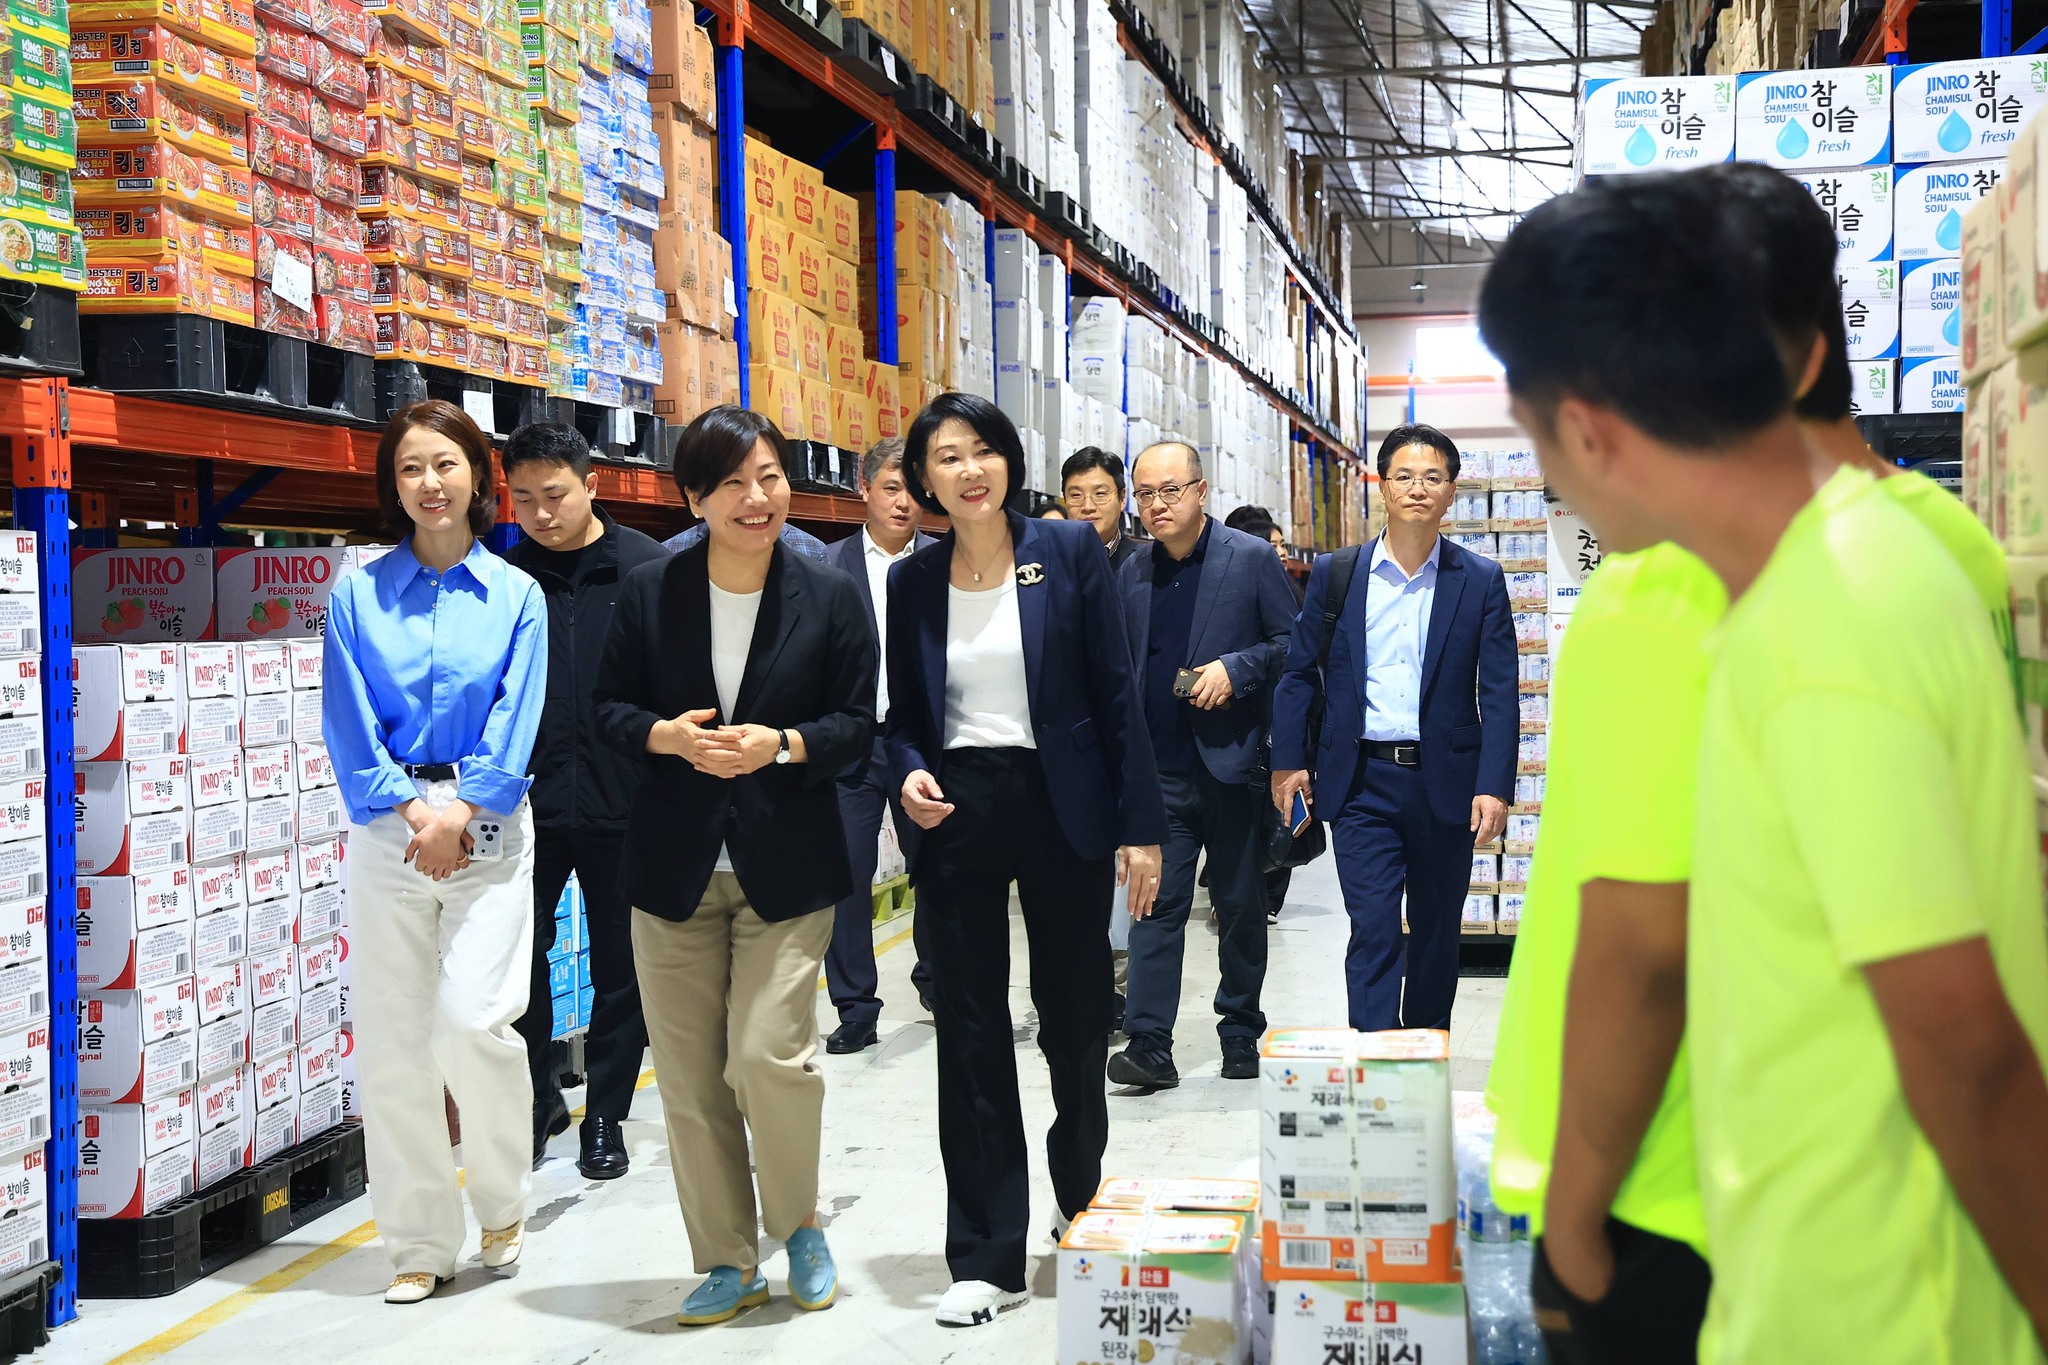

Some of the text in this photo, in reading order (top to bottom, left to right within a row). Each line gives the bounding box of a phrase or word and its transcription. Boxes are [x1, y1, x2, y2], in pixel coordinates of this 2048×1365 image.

[72, 32, 106, 41] OBSTER
[112, 34, 126, 56] 킹
[22, 39, 42, 54] KING
[1926, 74, 1970, 96] JINRO
[1974, 70, 2001, 98] 참
[73, 90, 101, 98] BSTER
[1615, 90, 1658, 109] JINRO
[1660, 88, 1686, 115] 참
[1766, 84, 1808, 104] JINRO
[1810, 80, 1837, 108] 참
[1925, 93, 1972, 105] CHAMISUL
[22, 103, 42, 118] KING
[1615, 109, 1659, 118] CHAMISUL
[1764, 103, 1810, 113] CHAMISUL
[1926, 106, 1948, 116] SOJU
[1975, 94, 2024, 124] 이슬
[1615, 120, 1636, 129] SOJU
[1661, 114, 1706, 141] 이슬
[1764, 115, 1786, 124] SOJU
[1812, 105, 1858, 132] 이슬
[1980, 129, 2016, 145] fresh
[77, 150, 108, 158] OBSTER
[1665, 146, 1698, 160] fresh
[1817, 140, 1850, 154] fresh
[116, 152, 130, 174] 킹
[20, 166, 40, 182] KING
[1815, 179, 1842, 206] 참
[1926, 173, 1969, 194] JINRO
[1924, 192, 1972, 204] CHAMISUL
[75, 210, 110, 218] OBSTER
[1925, 204, 1948, 213] SOJU
[115, 212, 131, 234] 킹
[35, 229, 56, 244] KING
[36, 241, 57, 255] NOODLE
[88, 268, 123, 277] OBSTER
[1931, 272, 1960, 290] JINR
[128, 271, 159, 294] 킹 컵
[1930, 290, 1960, 300] CHAMI
[1930, 302, 1954, 310] SOJU
[1932, 370, 1960, 388] JINR
[1930, 388, 1966, 398] CHAMIS
[1932, 400, 1954, 409] SOJU
[1508, 451, 1531, 461] Milkis
[1463, 534, 1486, 544] Milkis
[0, 558, 22, 576] 참이슬
[105, 556, 186, 592] JINRO
[250, 556, 331, 592] JINRO
[1514, 572, 1536, 582] Milkis
[122, 588, 168, 596] PEACH SOJU
[268, 586, 314, 596] PEACH SOJU
[149, 600, 186, 621] 복숭아에
[160, 614, 183, 637] 이슬
[125, 651, 138, 660] Fragile
[148, 668, 166, 684] 참이슬
[194, 666, 214, 687] JINRO
[252, 662, 270, 684] JINRO
[298, 658, 314, 678] JINRO
[2, 684, 26, 702] 참이슬
[132, 764, 146, 774] Fragile
[252, 766, 271, 787] JINRO
[304, 758, 322, 780] JINRO
[154, 780, 174, 796] 참이슬
[200, 772, 220, 796] JINRO
[8, 804, 30, 822] 참이슬
[305, 856, 321, 878] JINRO
[137, 878, 152, 888] Fragile
[254, 869, 272, 892] JINRO
[202, 877, 221, 903] JINRO
[160, 890, 178, 909] 참이슬
[10, 930, 32, 951] 참이슬
[306, 954, 322, 978] JINRO
[258, 972, 276, 996] JINRO
[144, 995, 158, 1006] Fragile
[204, 986, 223, 1012] JINRO
[166, 1005, 183, 1025] 참이슬
[8, 1054, 32, 1076] 참이슬
[306, 1054, 324, 1080] JINRO
[261, 1072, 277, 1098] JINRO
[146, 1104, 160, 1114] Fragile
[206, 1092, 224, 1120] JINRO
[166, 1112, 183, 1132] 참이슬
[6, 1176, 30, 1200] 참이슬
[263, 1186, 288, 1215] LOGISALL
[1102, 1341, 1128, 1359] 된장
